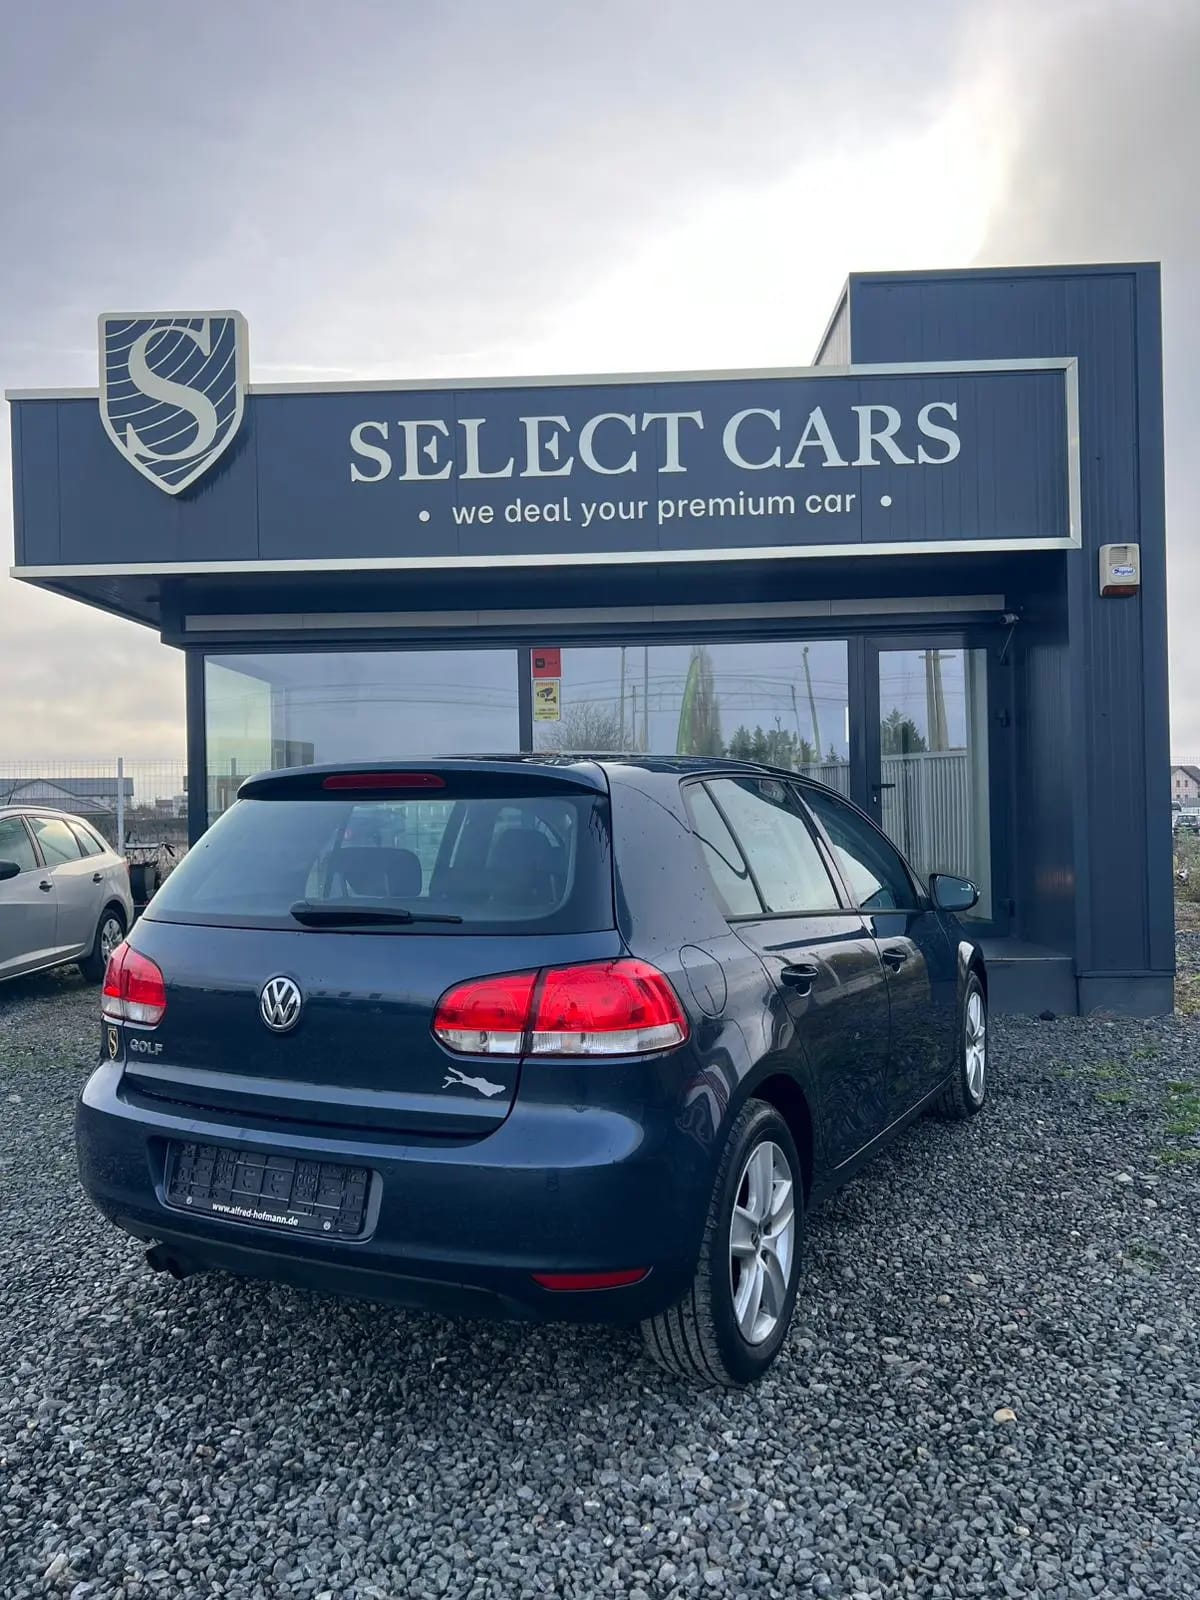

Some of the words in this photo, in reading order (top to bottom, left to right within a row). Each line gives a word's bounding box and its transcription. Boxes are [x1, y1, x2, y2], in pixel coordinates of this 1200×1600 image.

[127, 317, 218, 461] S
[350, 410, 705, 482] SELECT
[722, 401, 961, 470] CARS
[452, 504, 494, 525] we
[504, 496, 572, 523] deal
[580, 499, 649, 528] your
[657, 490, 796, 525] premium
[804, 492, 856, 514] car
[129, 1038, 164, 1056] GOLF
[211, 1201, 299, 1227] www.alfred-hofmann.de
